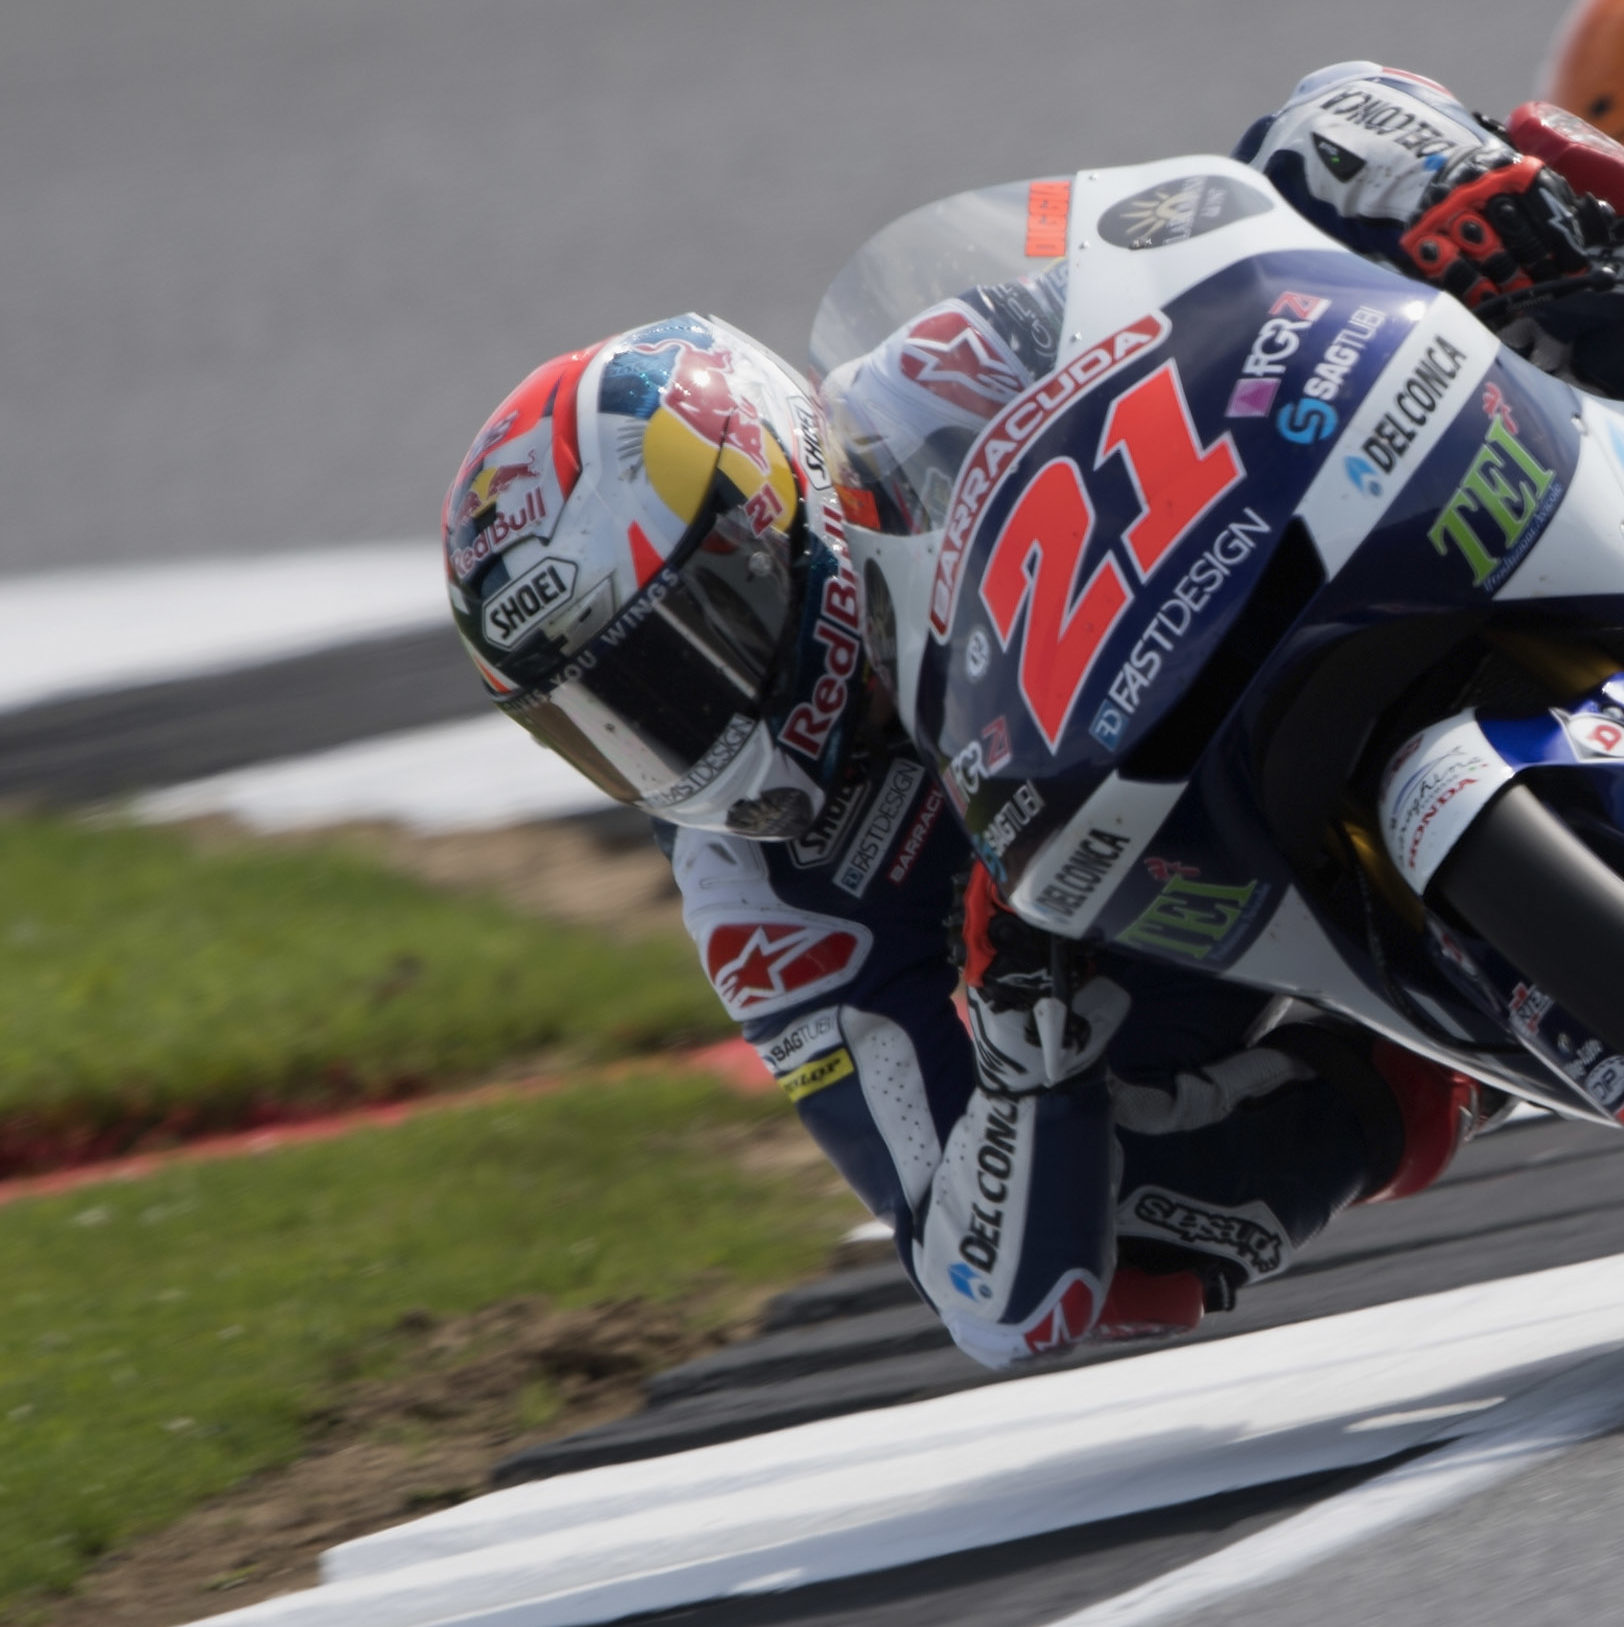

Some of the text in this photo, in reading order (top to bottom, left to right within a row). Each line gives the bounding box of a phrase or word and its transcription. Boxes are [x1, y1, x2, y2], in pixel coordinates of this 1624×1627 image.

[450, 486, 547, 578] Red Bull
[744, 481, 784, 538] 21
[933, 330, 1154, 617] BARRACUDA
[1427, 413, 1556, 589] TEI
[489, 566, 567, 640] SHOEI
[979, 357, 1247, 757] 21
[551, 650, 597, 688] YOU
[601, 567, 680, 647] WINGS
[778, 618, 859, 758] Red
[1115, 872, 1258, 960] TEI
